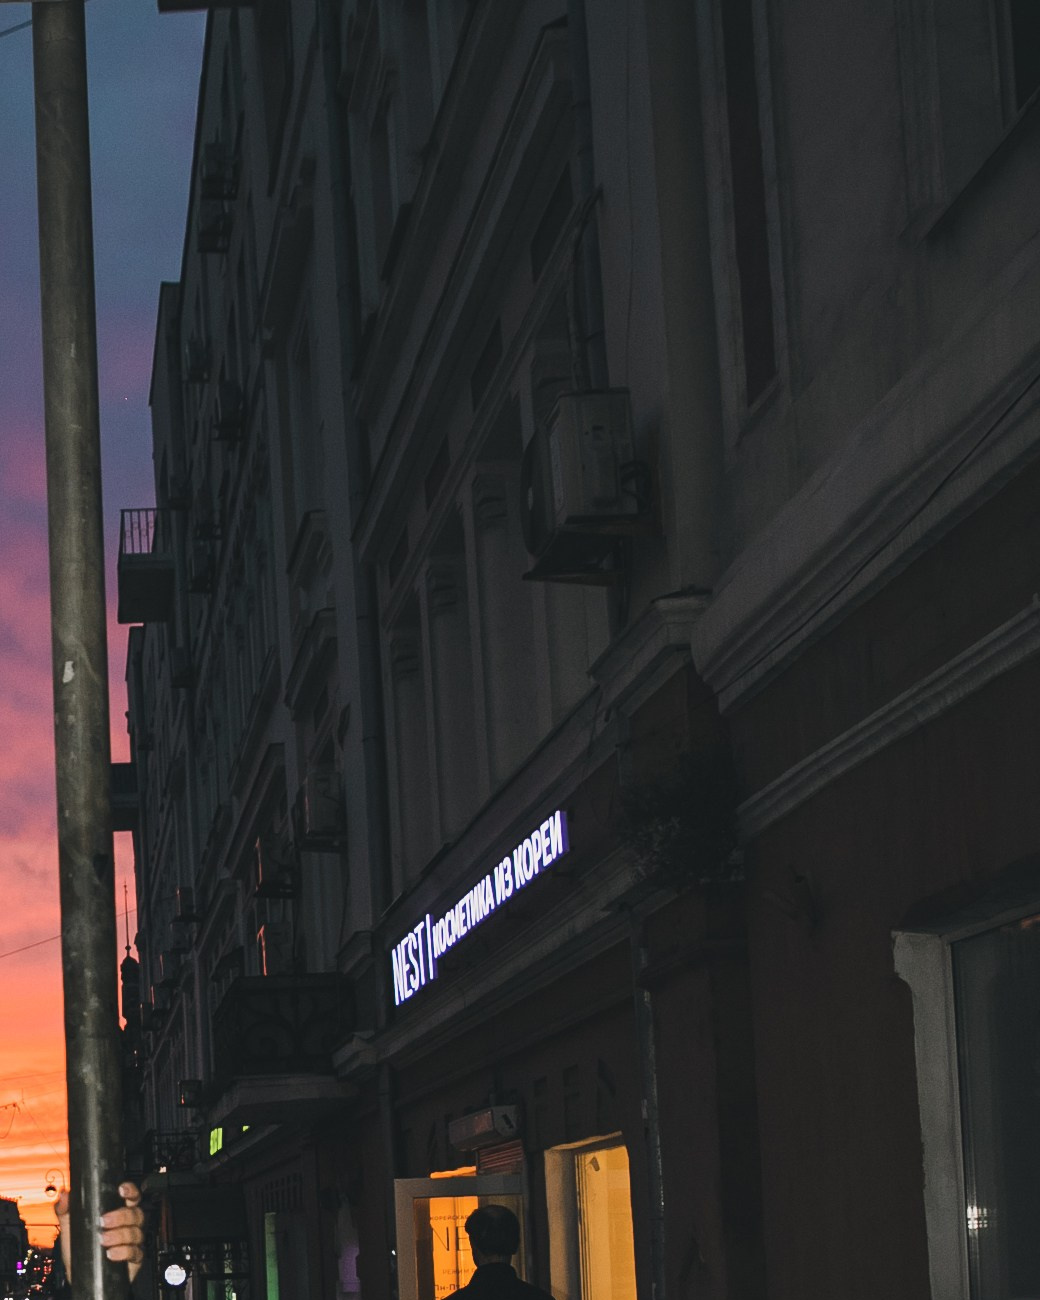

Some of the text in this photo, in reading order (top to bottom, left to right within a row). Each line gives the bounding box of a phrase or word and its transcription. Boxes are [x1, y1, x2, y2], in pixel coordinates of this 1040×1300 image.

[391, 810, 564, 1005] NEST КОСМЕТИКА ИЗ КОРЕИ
